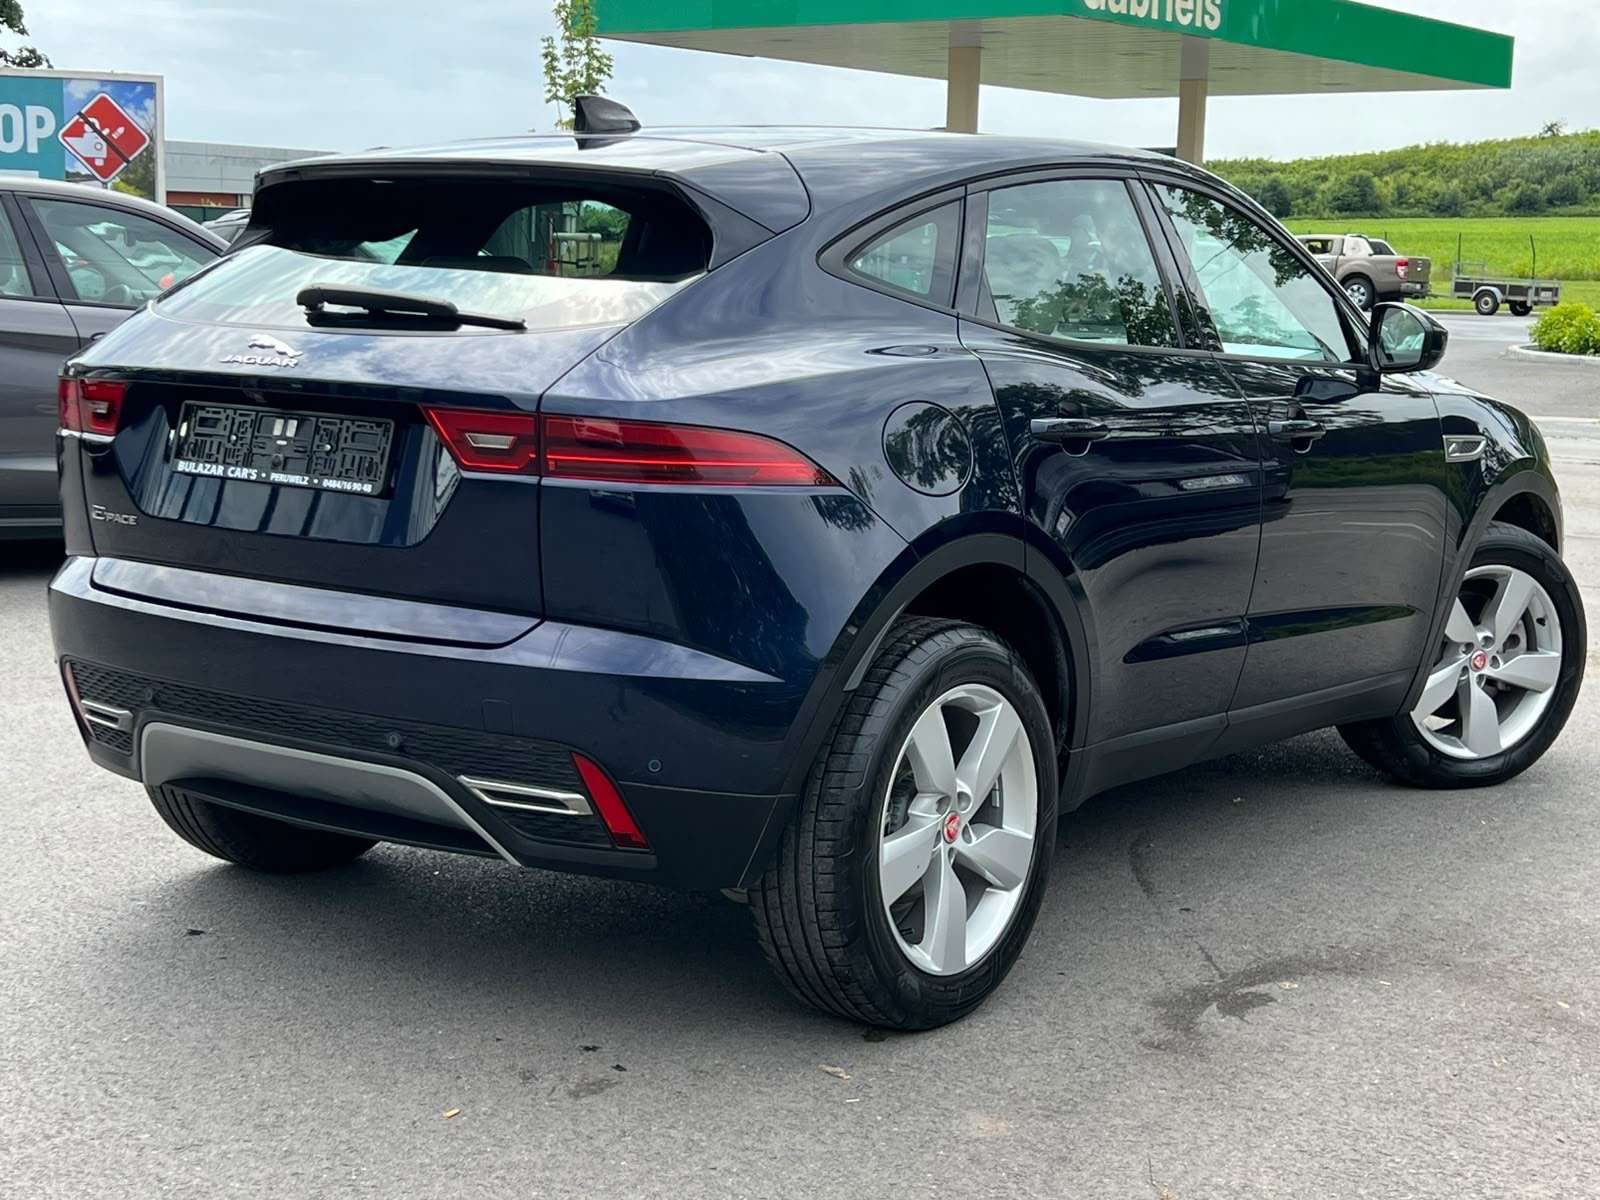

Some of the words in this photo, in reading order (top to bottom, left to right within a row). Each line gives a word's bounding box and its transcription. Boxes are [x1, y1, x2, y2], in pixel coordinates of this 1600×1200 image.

[1083, 0, 1222, 31] riels
[220, 354, 299, 368] JAGUAR
[177, 461, 224, 477] BULAZAR
[227, 466, 258, 481] CAR'S
[270, 472, 310, 485] PERUWELZ
